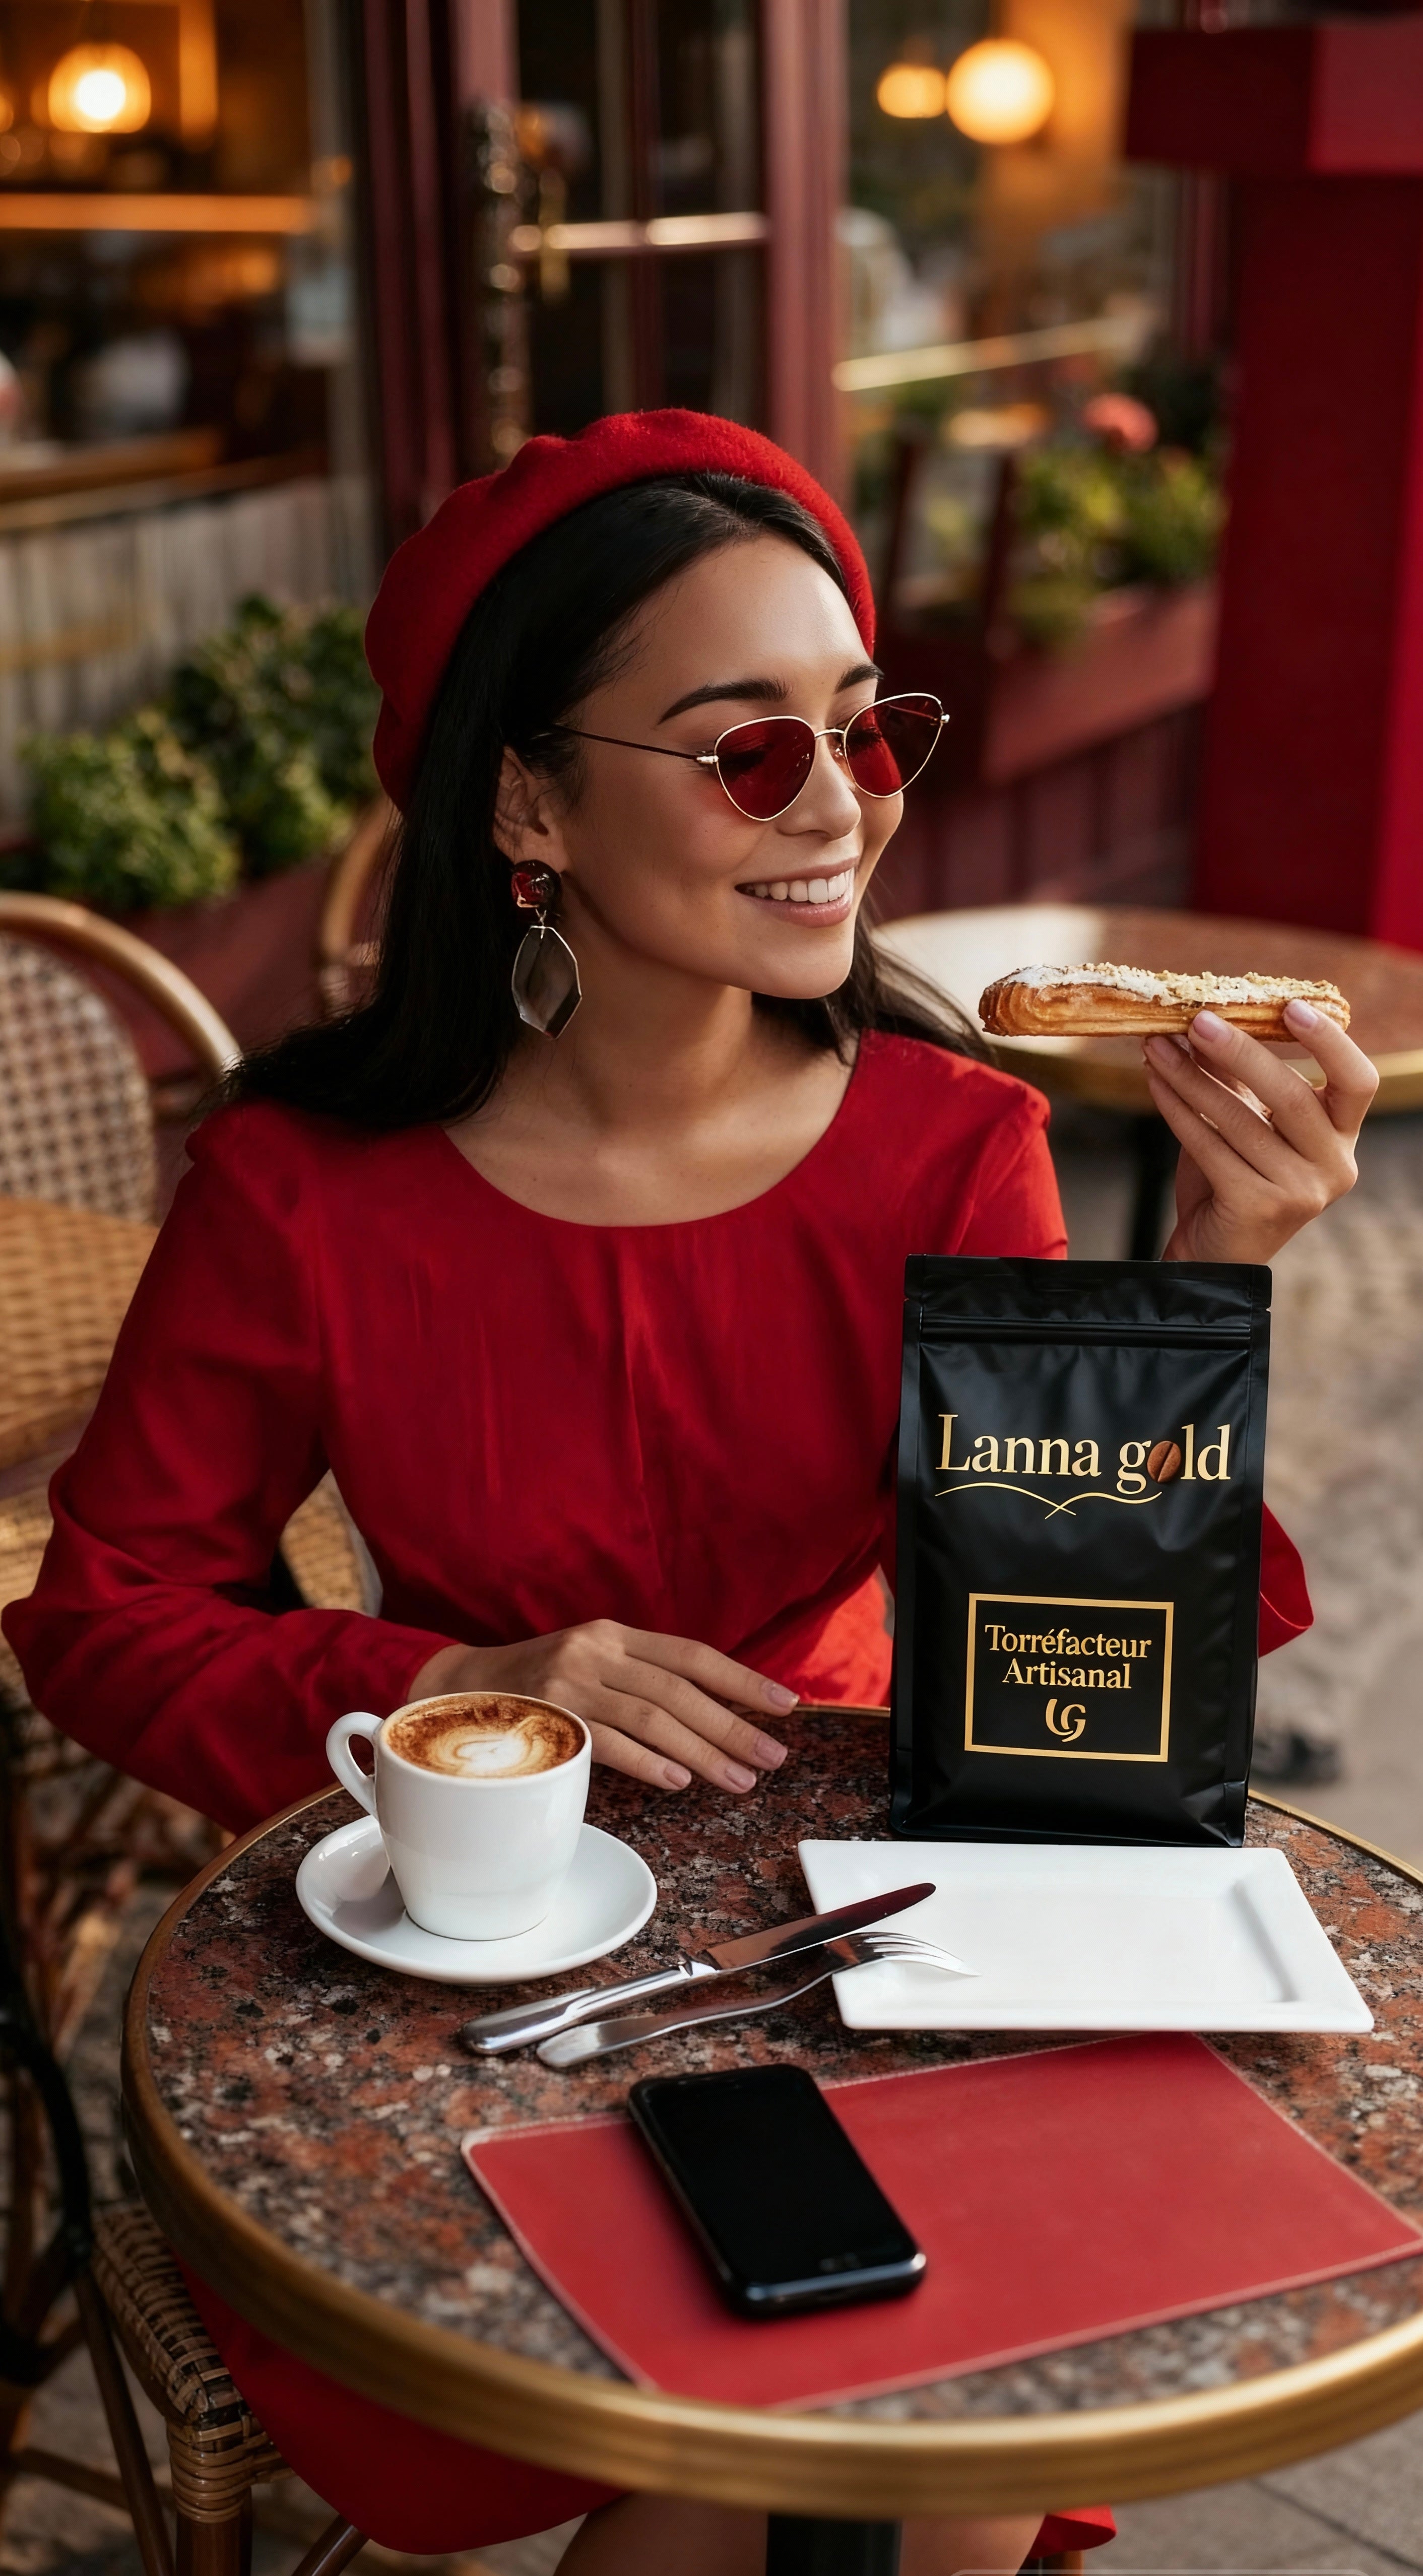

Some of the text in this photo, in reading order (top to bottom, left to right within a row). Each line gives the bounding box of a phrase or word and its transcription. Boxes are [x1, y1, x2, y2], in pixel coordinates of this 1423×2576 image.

[935, 1414, 1101, 1478] Lanna
[984, 1624, 1152, 1659] Torréfacteur
[1002, 1657, 1132, 1689] Artisanal
